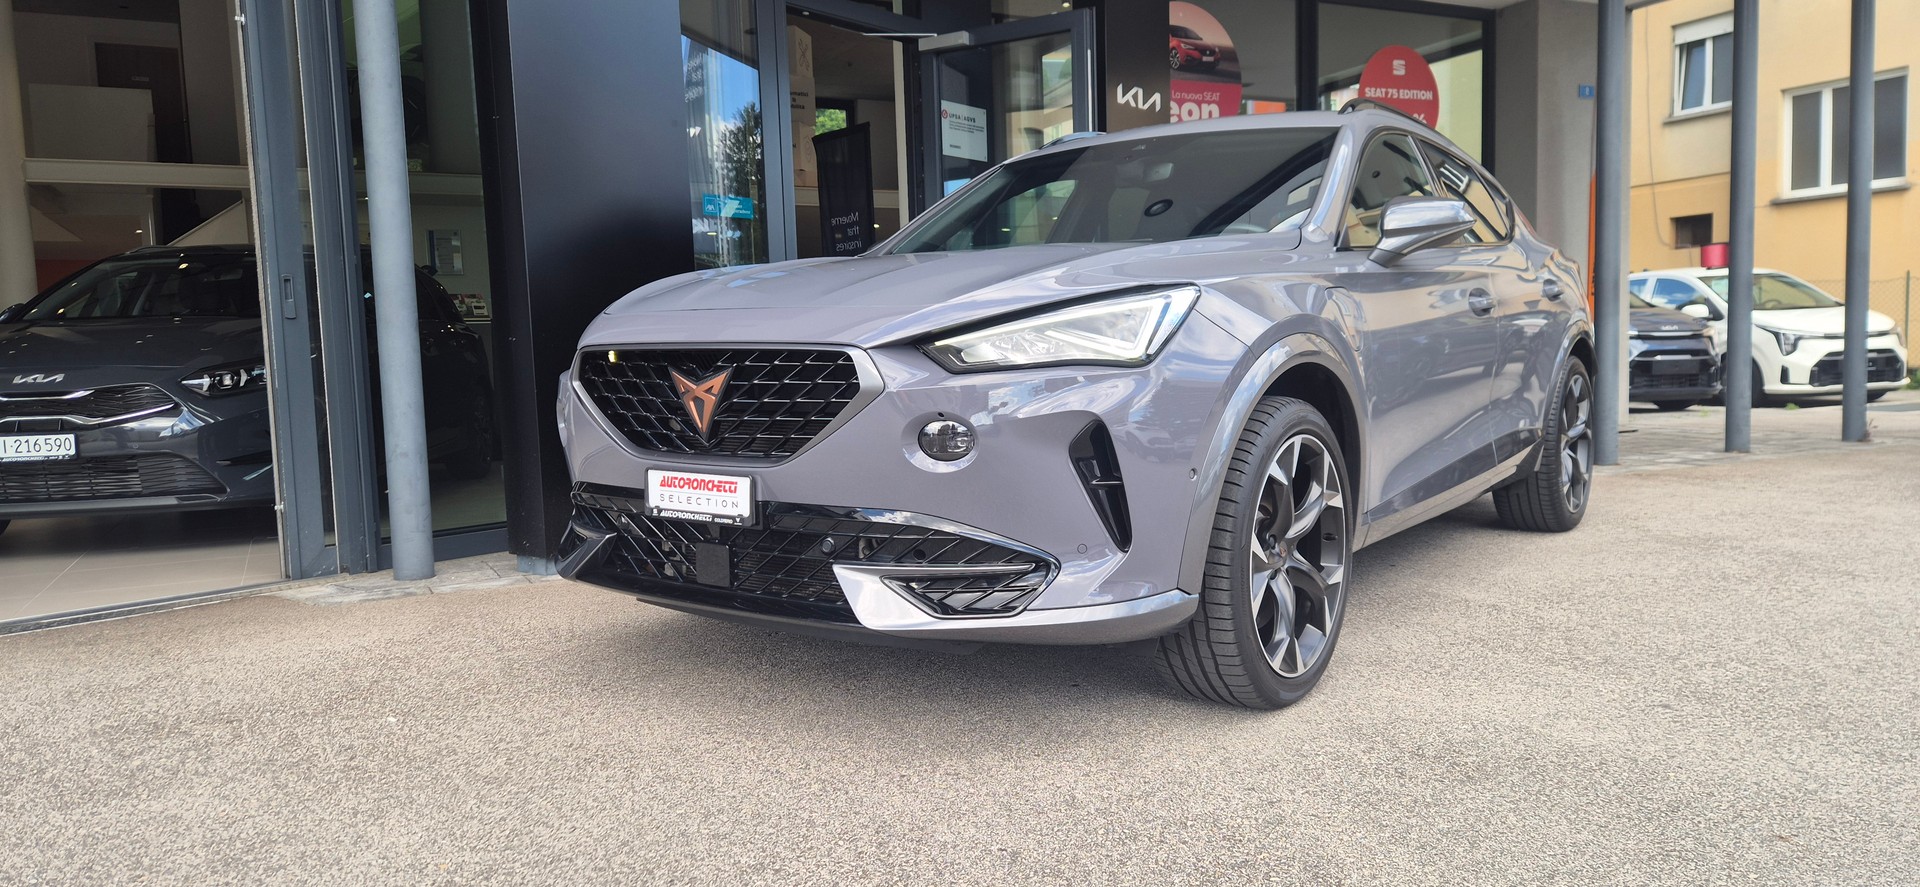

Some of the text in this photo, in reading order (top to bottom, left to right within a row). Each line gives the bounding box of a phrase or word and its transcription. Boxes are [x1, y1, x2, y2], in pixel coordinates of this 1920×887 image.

[1117, 83, 1161, 113] KIA
[1172, 90, 1220, 101] La nuova SEAT
[1365, 87, 1433, 100] SEAT 75 EDITION
[12, 373, 65, 384] KIA
[659, 475, 738, 494] AUTORONCHETTI
[660, 493, 739, 509] SELECTION
